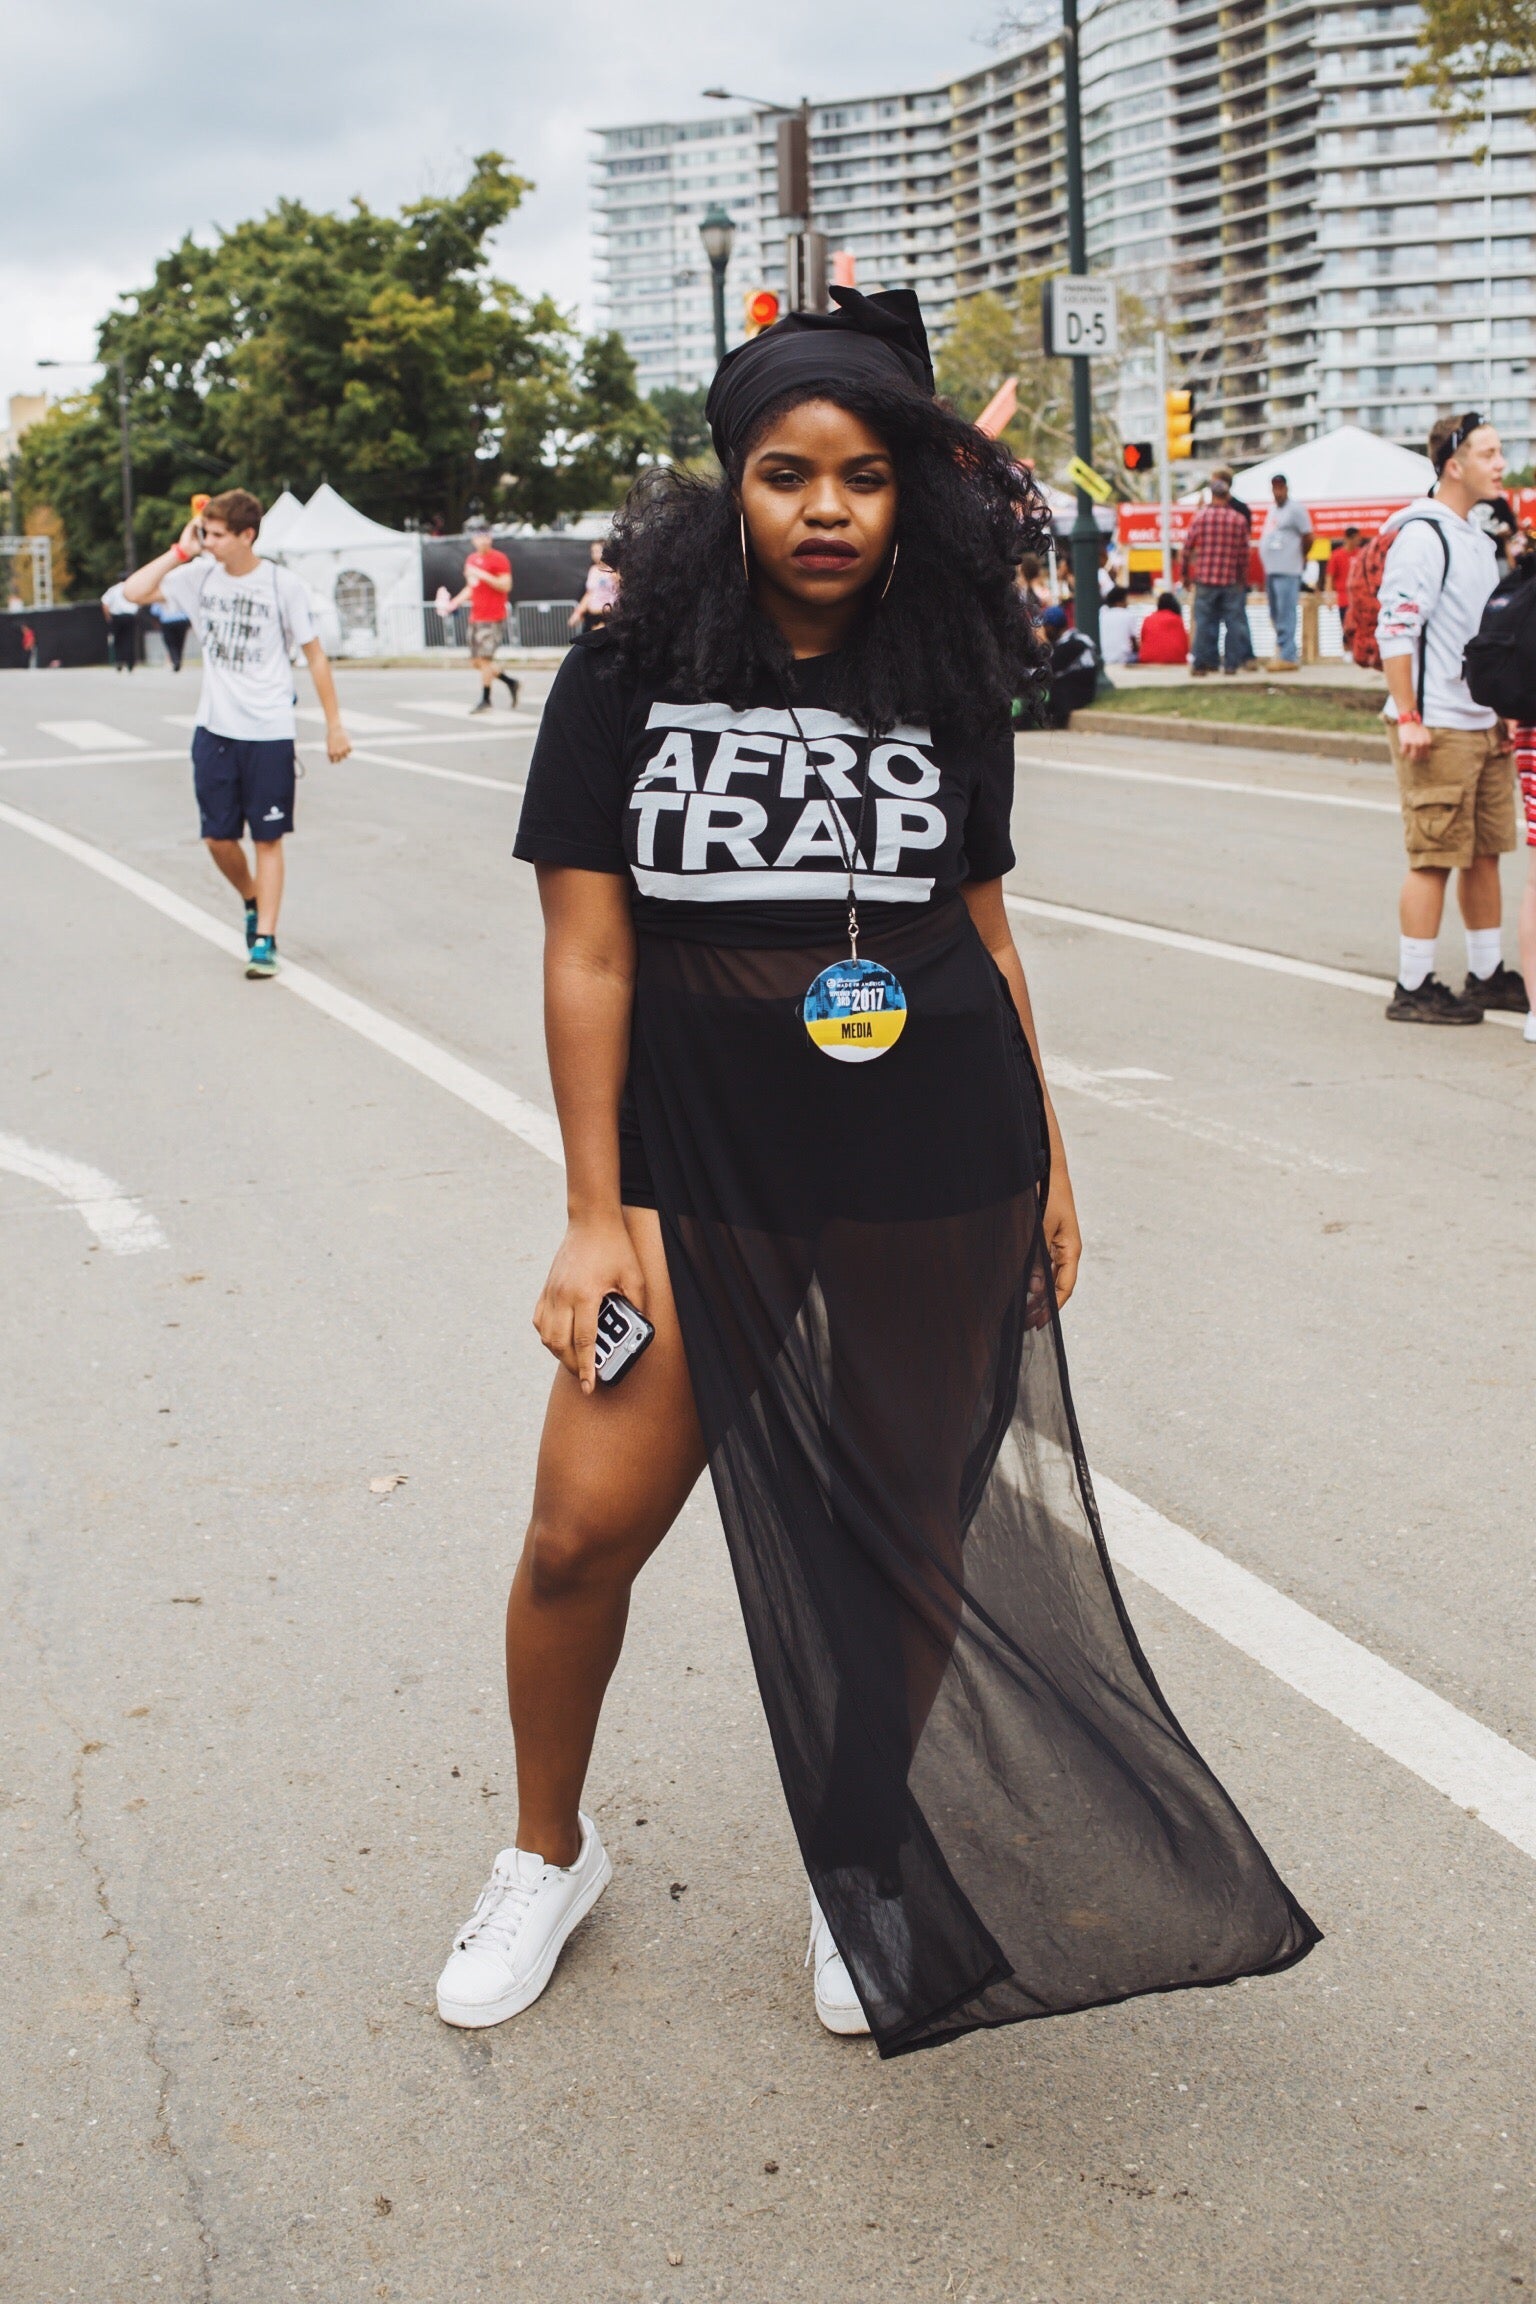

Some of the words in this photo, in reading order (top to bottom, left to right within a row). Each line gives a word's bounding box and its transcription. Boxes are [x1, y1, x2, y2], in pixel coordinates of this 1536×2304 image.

[1067, 312, 1107, 345] D-5
[634, 731, 942, 799] AFRO
[629, 791, 948, 872] TRAP
[836, 996, 851, 1007] 3RD
[852, 988, 885, 1011] 2017
[841, 1022, 873, 1039] MEDIA
